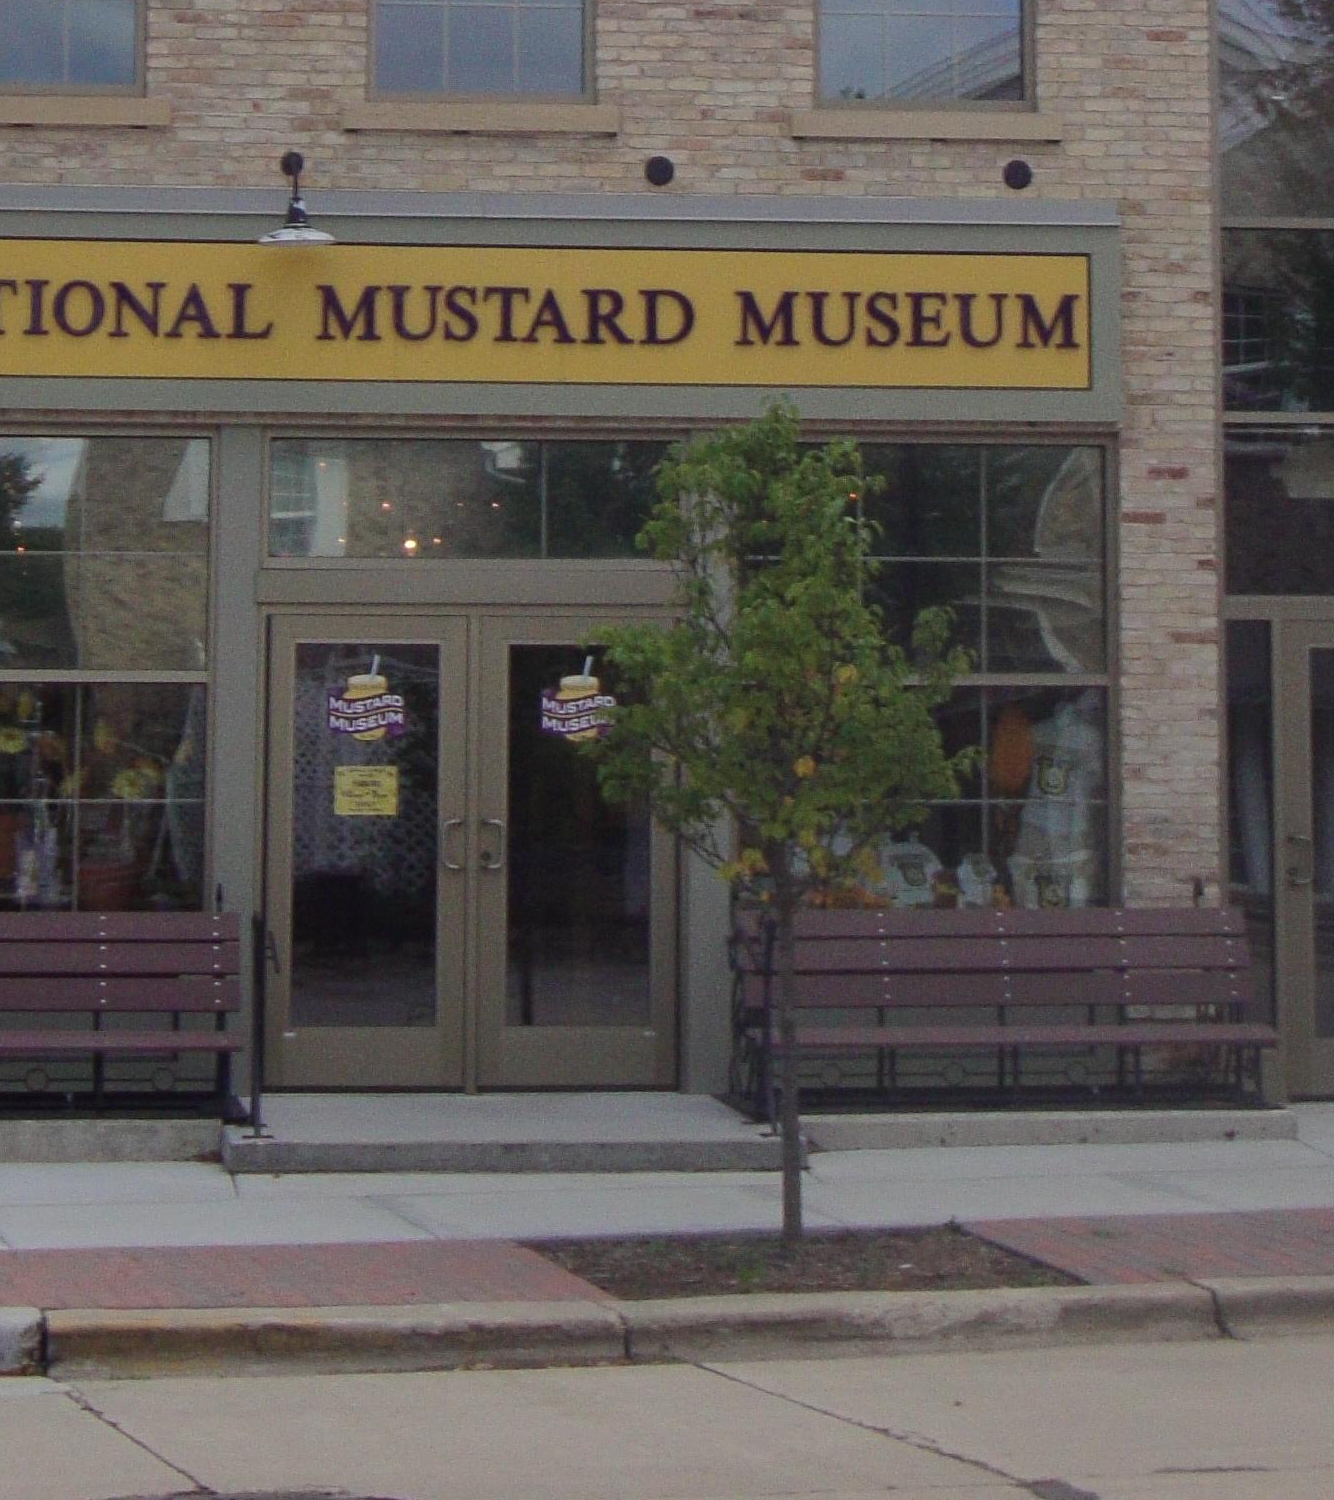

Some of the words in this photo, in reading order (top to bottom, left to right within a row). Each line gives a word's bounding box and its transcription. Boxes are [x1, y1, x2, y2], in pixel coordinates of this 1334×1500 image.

[314, 283, 696, 347] MUSTARD
[734, 289, 1082, 350] MUSEUM
[329, 694, 405, 713] MUSTARD
[541, 694, 617, 714] MUSTARD
[329, 711, 404, 732] MUSEUM
